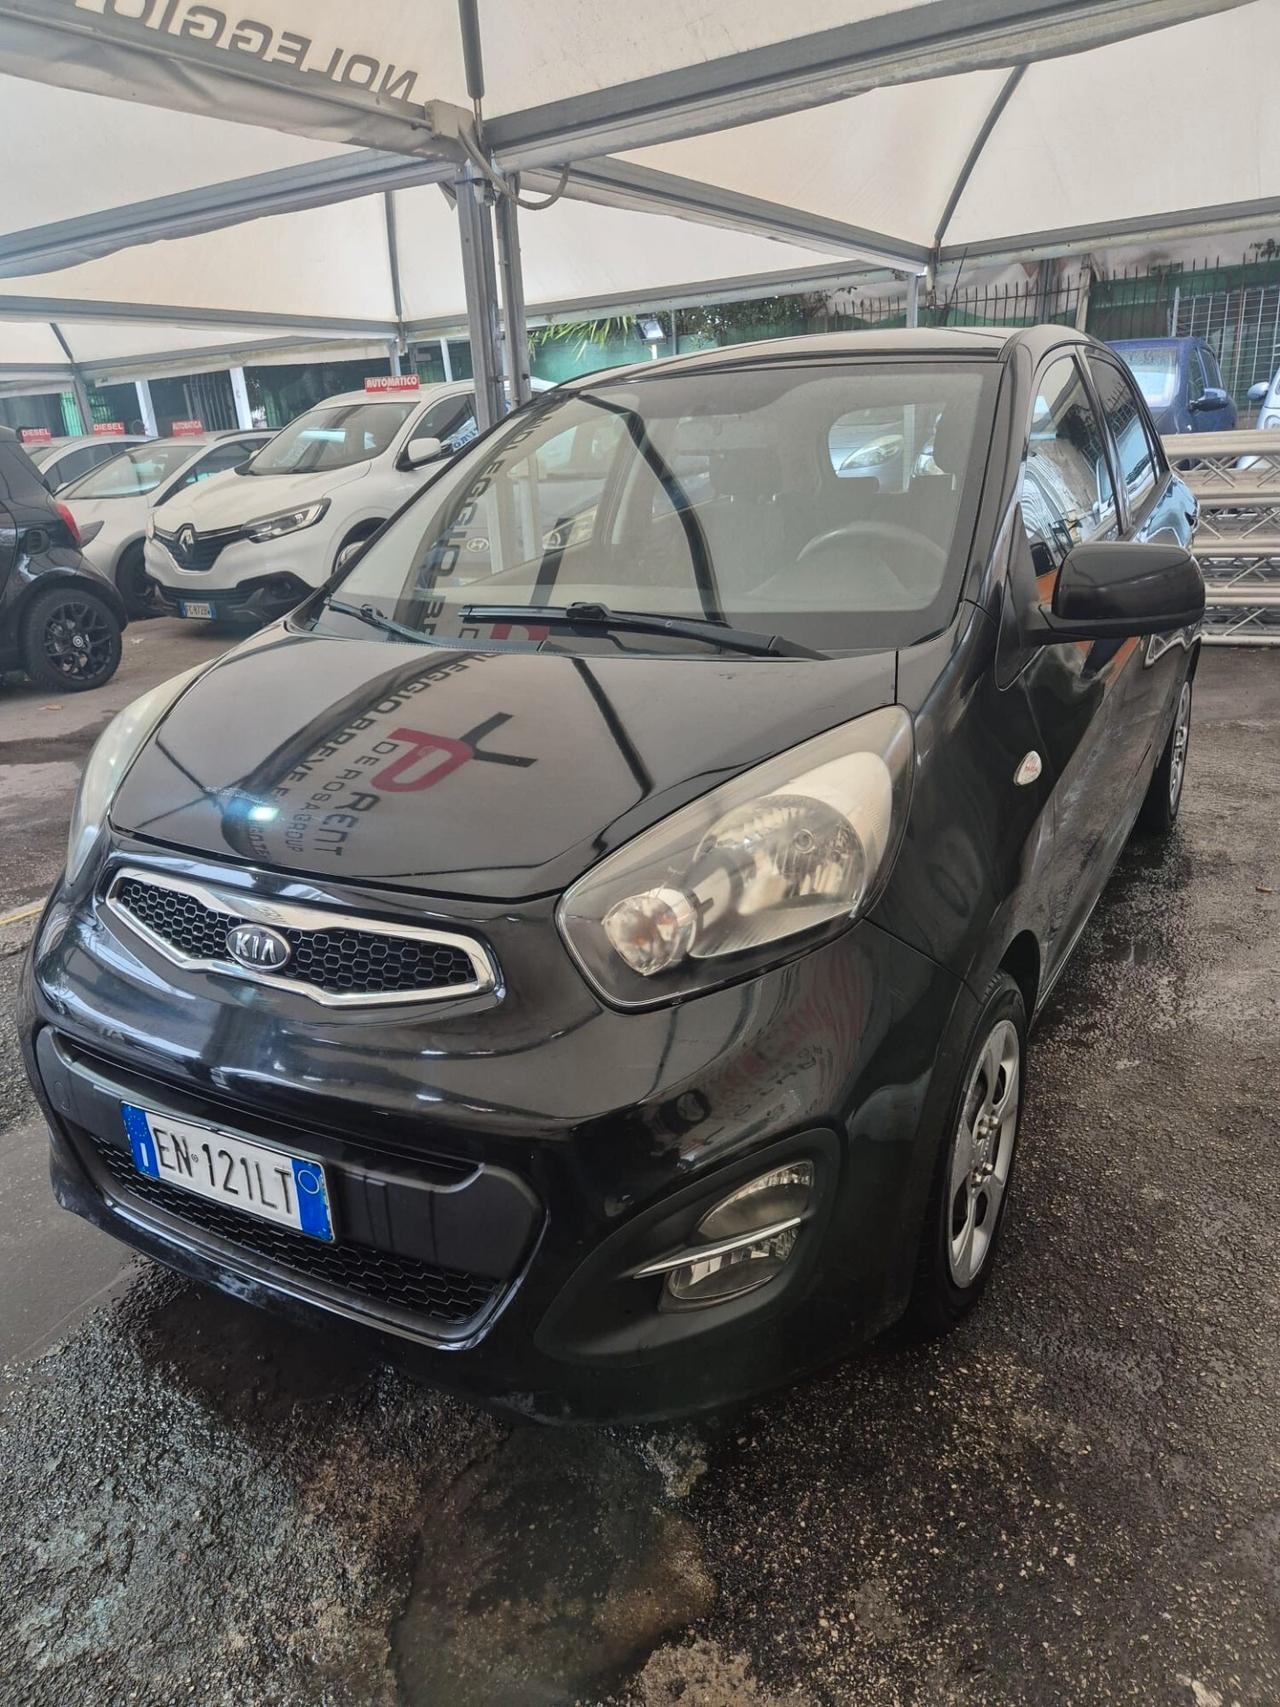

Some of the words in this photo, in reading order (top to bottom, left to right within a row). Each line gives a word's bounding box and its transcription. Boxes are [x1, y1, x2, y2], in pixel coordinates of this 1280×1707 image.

[366, 376, 418, 388] AUTOMATICO
[93, 422, 123, 431] DIESEL
[22, 428, 49, 437] DIESEL
[235, 932, 277, 964] KIA
